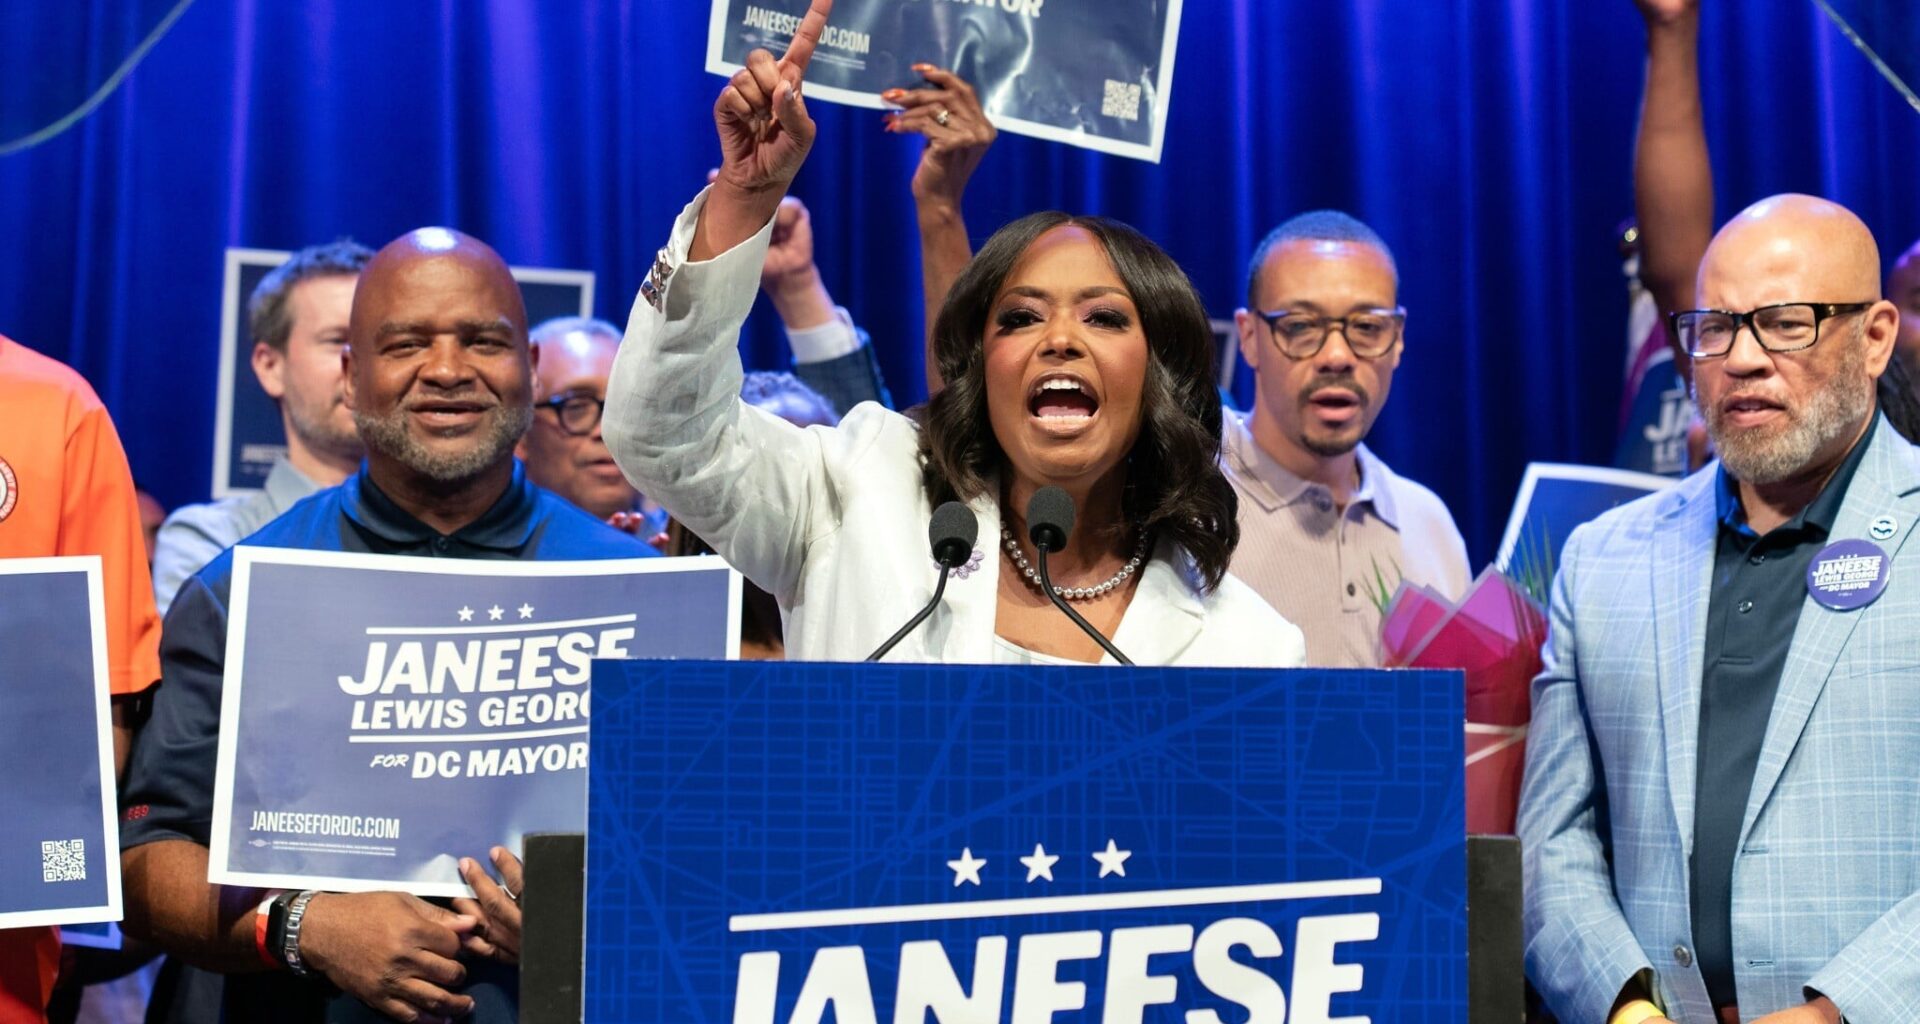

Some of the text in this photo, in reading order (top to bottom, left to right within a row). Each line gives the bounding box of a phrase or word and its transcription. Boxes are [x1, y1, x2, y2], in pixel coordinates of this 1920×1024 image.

[742, 5, 870, 54] JANEESEDC.COM
[1812, 559, 1881, 577] JANEESE
[1840, 581, 1870, 591] MAYOR
[351, 691, 590, 730] LEWIS GEOR
[369, 742, 589, 779] FOR DC MAYOR
[250, 810, 400, 840] JANEESEFORDC.COM
